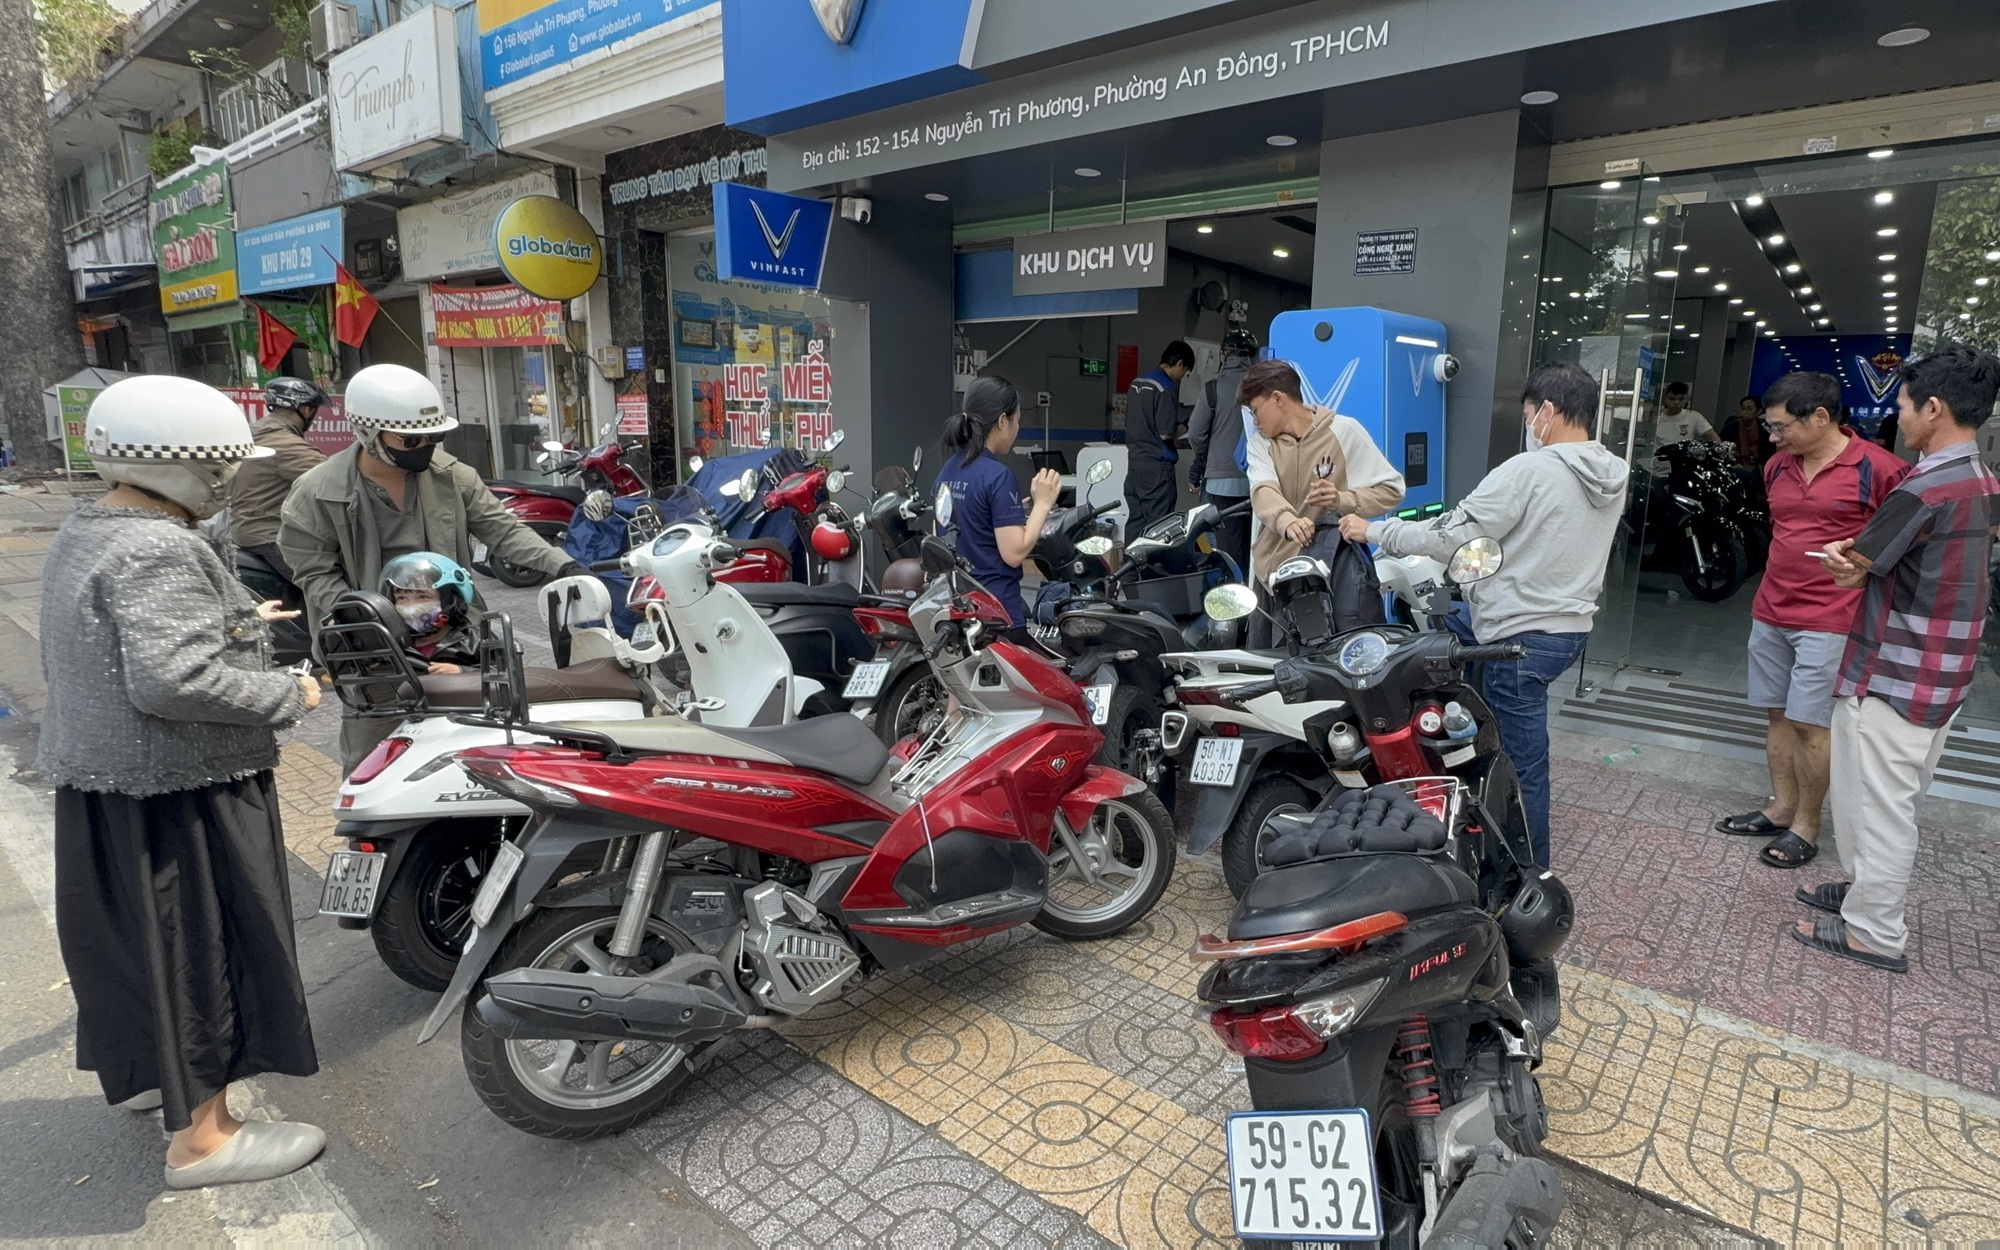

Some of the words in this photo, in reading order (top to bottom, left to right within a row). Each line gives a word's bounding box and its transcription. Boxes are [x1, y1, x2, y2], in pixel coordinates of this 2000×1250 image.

[503, 33, 517, 49] 156
[544, 16, 556, 33] Tri
[579, 11, 642, 46] www.globalart.vn
[340, 39, 415, 130] Triumph
[803, 151, 823, 170] Địa
[828, 142, 850, 164] chỉ:
[925, 111, 983, 146] Nguyễn
[989, 108, 1011, 129] Tri
[1018, 95, 1090, 124] Phương,
[1093, 75, 1168, 108] Phường
[1175, 66, 1207, 91] An
[1217, 52, 1288, 82] Đông,
[1290, 20, 1390, 65] TPHCM
[610, 177, 647, 204] TRUNG
[648, 169, 674, 197] TÂM
[674, 164, 699, 191] DẠY
[700, 157, 720, 184] VẼ
[721, 151, 741, 180] MỸ
[261, 252, 278, 275] KHU
[280, 241, 298, 271] PHỐ
[300, 246, 312, 268] 29
[507, 234, 592, 260] globalart
[1020, 251, 1060, 276] KHU
[1066, 246, 1115, 277] DỊCH
[1122, 242, 1154, 272] VỤ
[1358, 244, 1375, 255] CÔNG
[1376, 242, 1394, 255] NGHỆ
[1395, 243, 1414, 252] XANH
[750, 261, 805, 277] VINFAST
[474, 317, 498, 339] MUA
[498, 318, 505, 338] 1
[724, 363, 769, 409] HỌC
[1200, 741, 1235, 760] 50-N1
[1193, 763, 1233, 783] 403.67
[325, 885, 372, 913] 104.85
[1247, 1119, 1350, 1170] 59-G2
[1239, 1177, 1371, 1230] 715.32
[1291, 1241, 1341, 1250] SUZUKI
